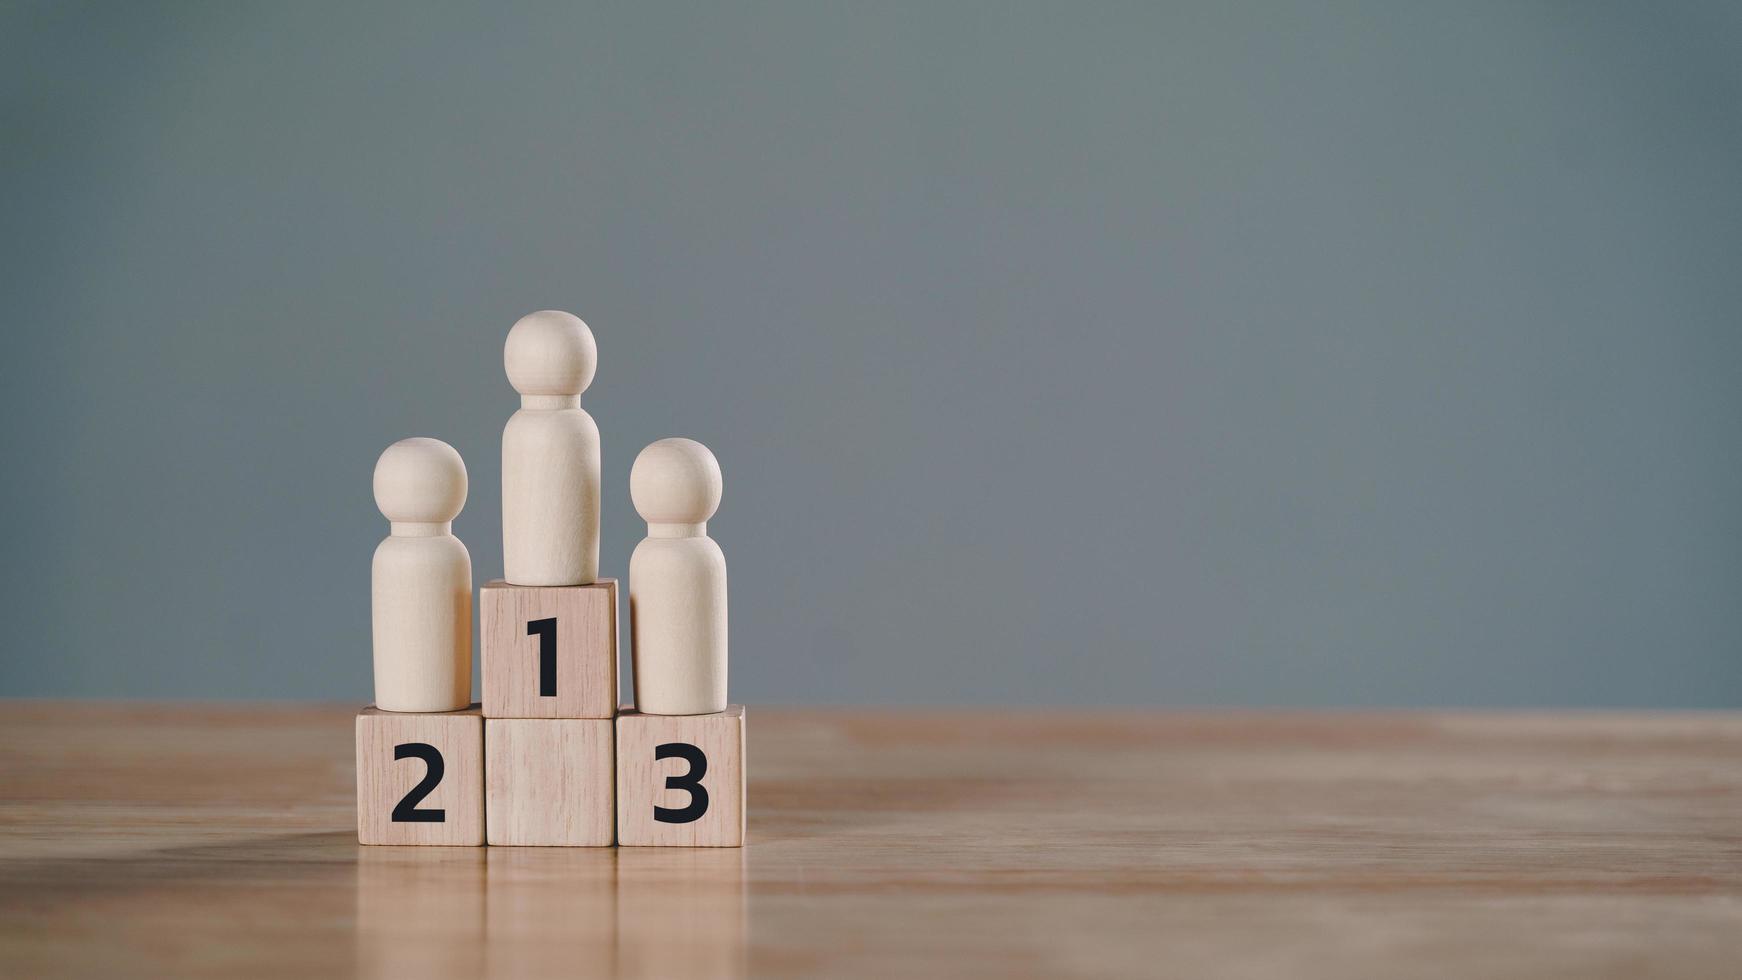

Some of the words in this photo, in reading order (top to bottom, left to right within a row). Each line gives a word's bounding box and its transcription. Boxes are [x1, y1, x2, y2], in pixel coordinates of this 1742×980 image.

[527, 617, 557, 697] 1
[391, 742, 446, 823] 2
[653, 743, 709, 824] 3
